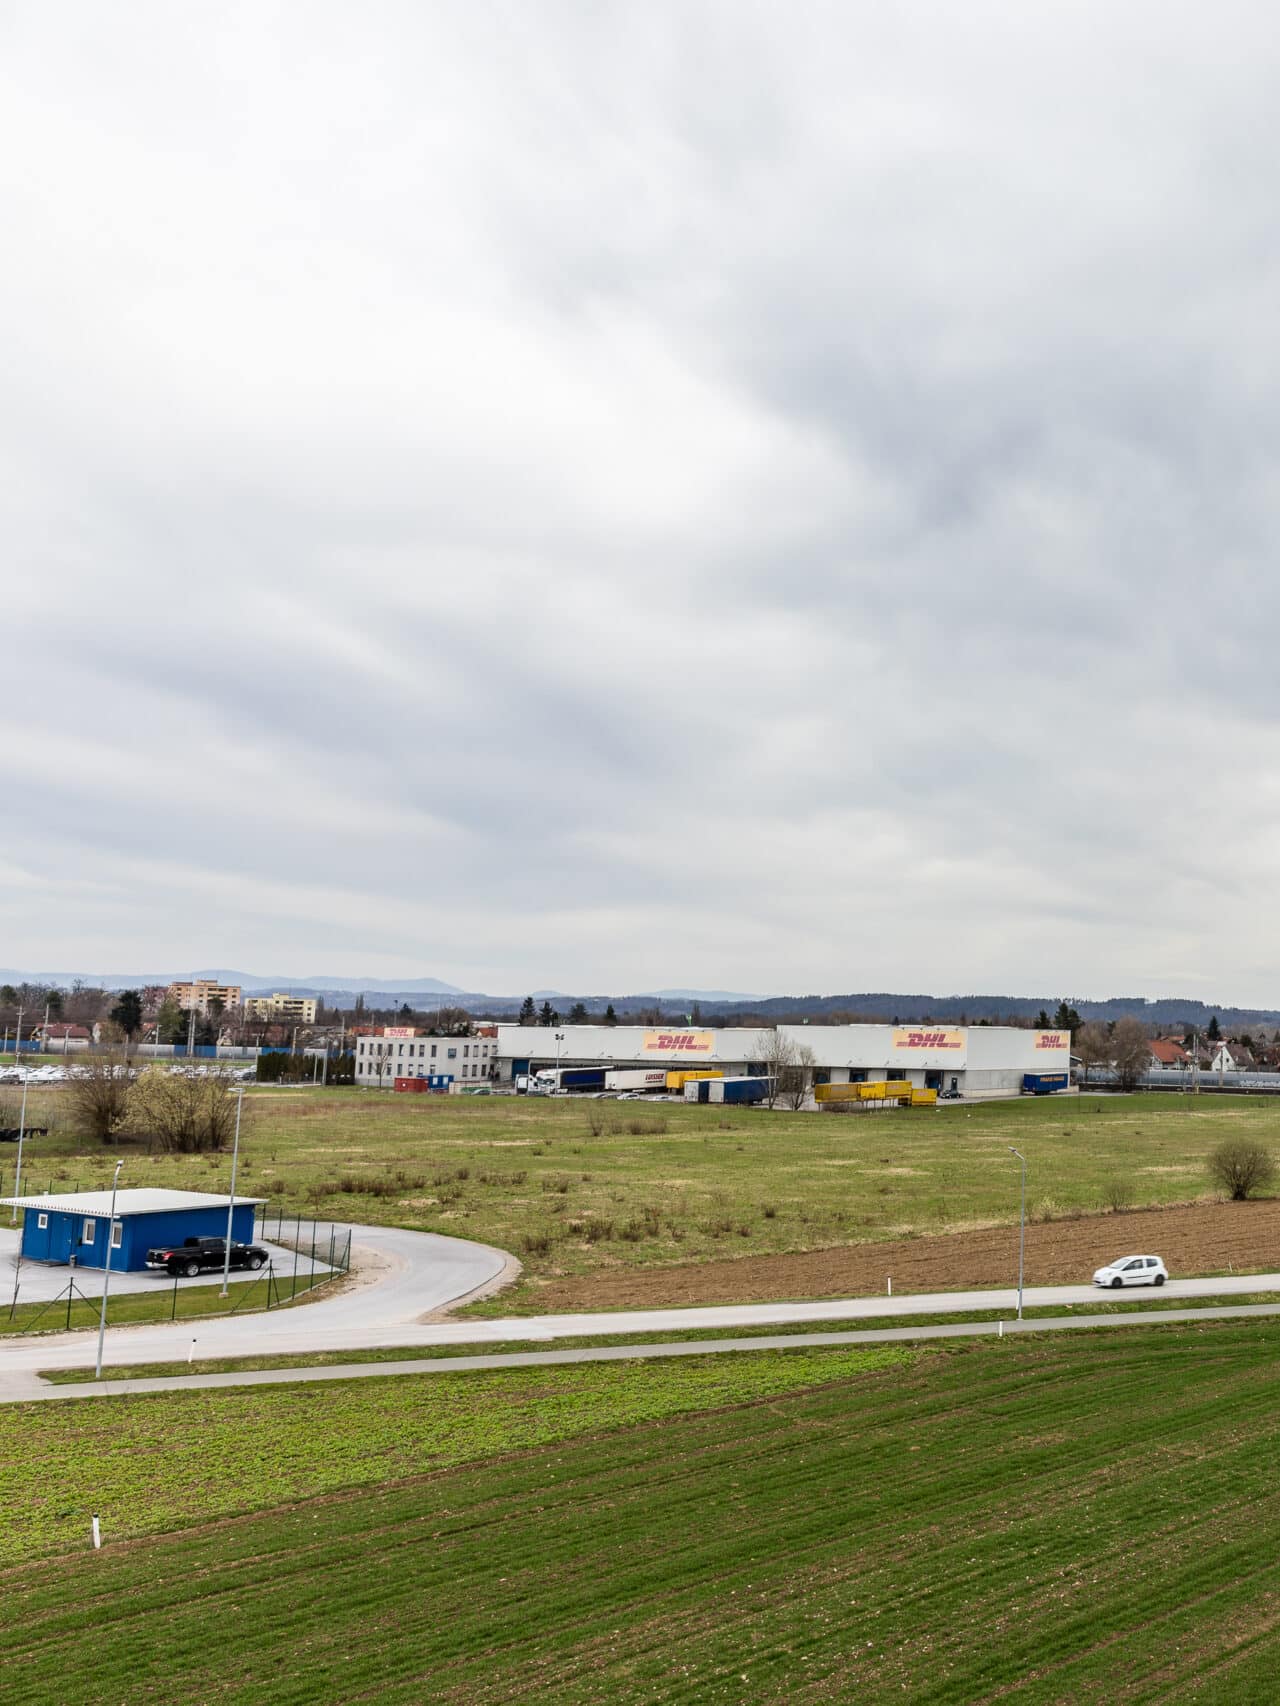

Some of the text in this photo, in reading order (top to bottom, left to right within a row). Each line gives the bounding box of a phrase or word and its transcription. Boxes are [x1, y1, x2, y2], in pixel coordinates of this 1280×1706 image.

[657, 1034, 698, 1050] DHL
[907, 1033, 949, 1048] DHL
[1040, 1035, 1063, 1049] DHL
